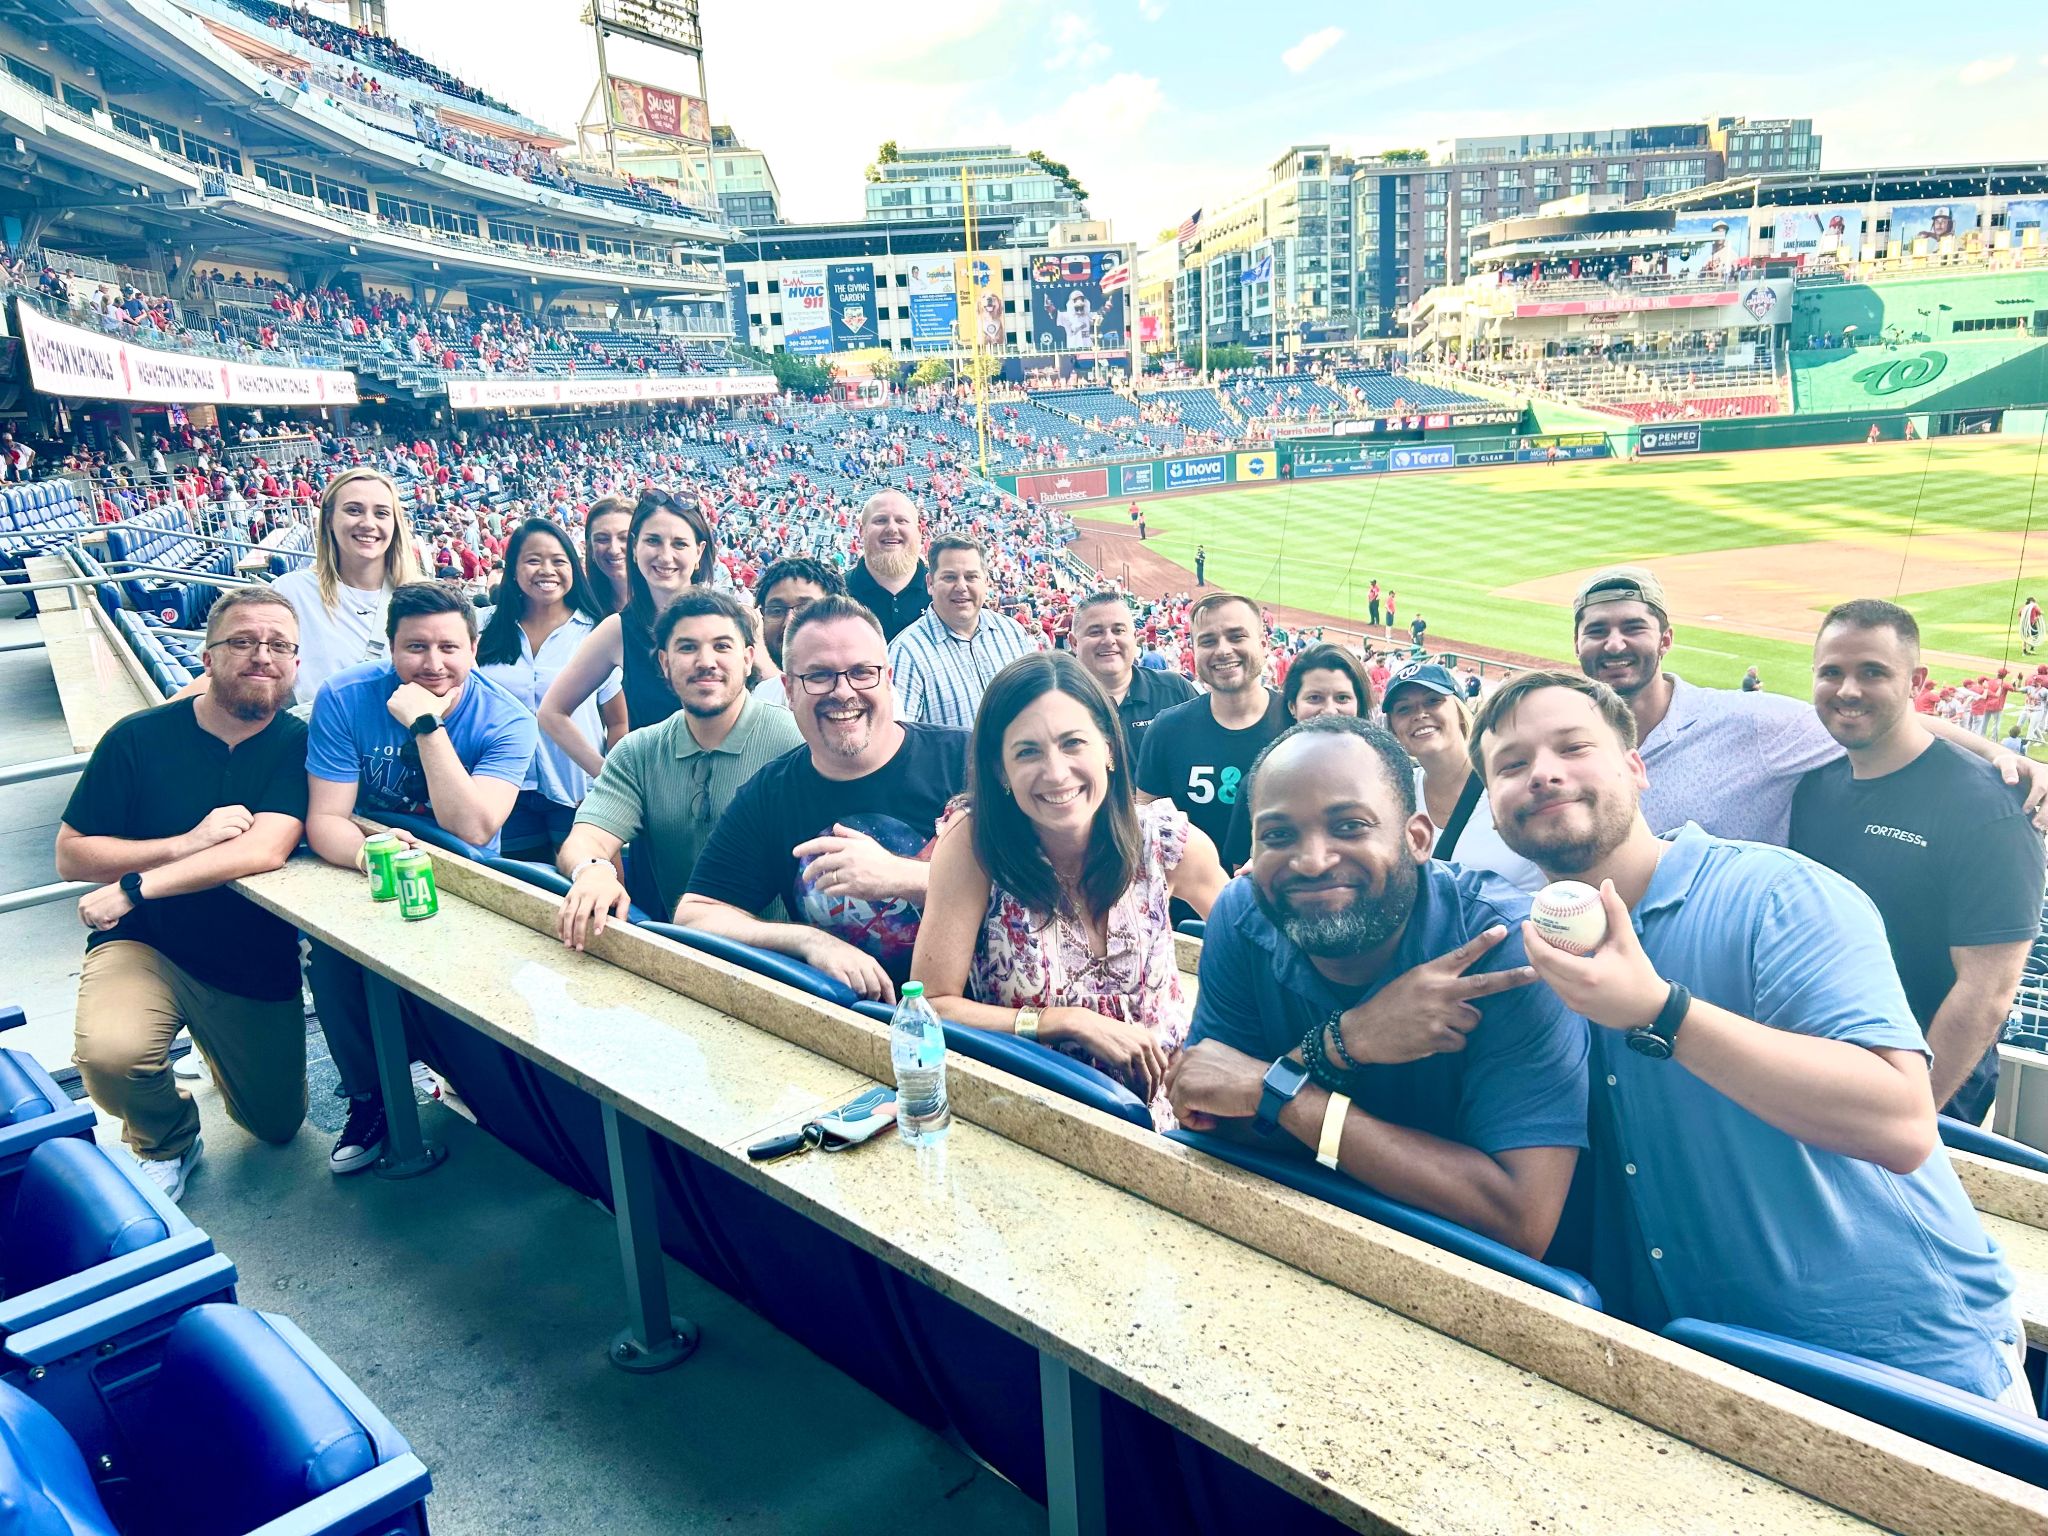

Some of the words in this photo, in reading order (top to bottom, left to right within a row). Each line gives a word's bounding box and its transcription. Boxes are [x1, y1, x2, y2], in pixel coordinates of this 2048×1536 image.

[646, 91, 676, 118] SMASH
[1783, 241, 1796, 249] LANE
[1797, 240, 1817, 248] THOMAS
[1543, 266, 1568, 275] ULTRA
[1582, 264, 1605, 273] LOFT
[834, 284, 847, 293] THE
[847, 283, 870, 293] GIVING
[1035, 281, 1097, 289] STEAMFITT
[788, 286, 825, 299] HVAC
[840, 293, 866, 303] GARDEN
[803, 296, 824, 309] 911
[1486, 411, 1519, 424] FAN
[1276, 427, 1303, 437] Harris
[1303, 426, 1331, 436] Teeter
[1657, 432, 1697, 441] PENFED
[1411, 450, 1449, 465] Terra
[1480, 454, 1504, 462] CLEAR
[1185, 461, 1221, 477] Inova
[1039, 490, 1088, 503] Budweiser
[1186, 765, 1242, 805] 58
[399, 876, 433, 907] IPA
